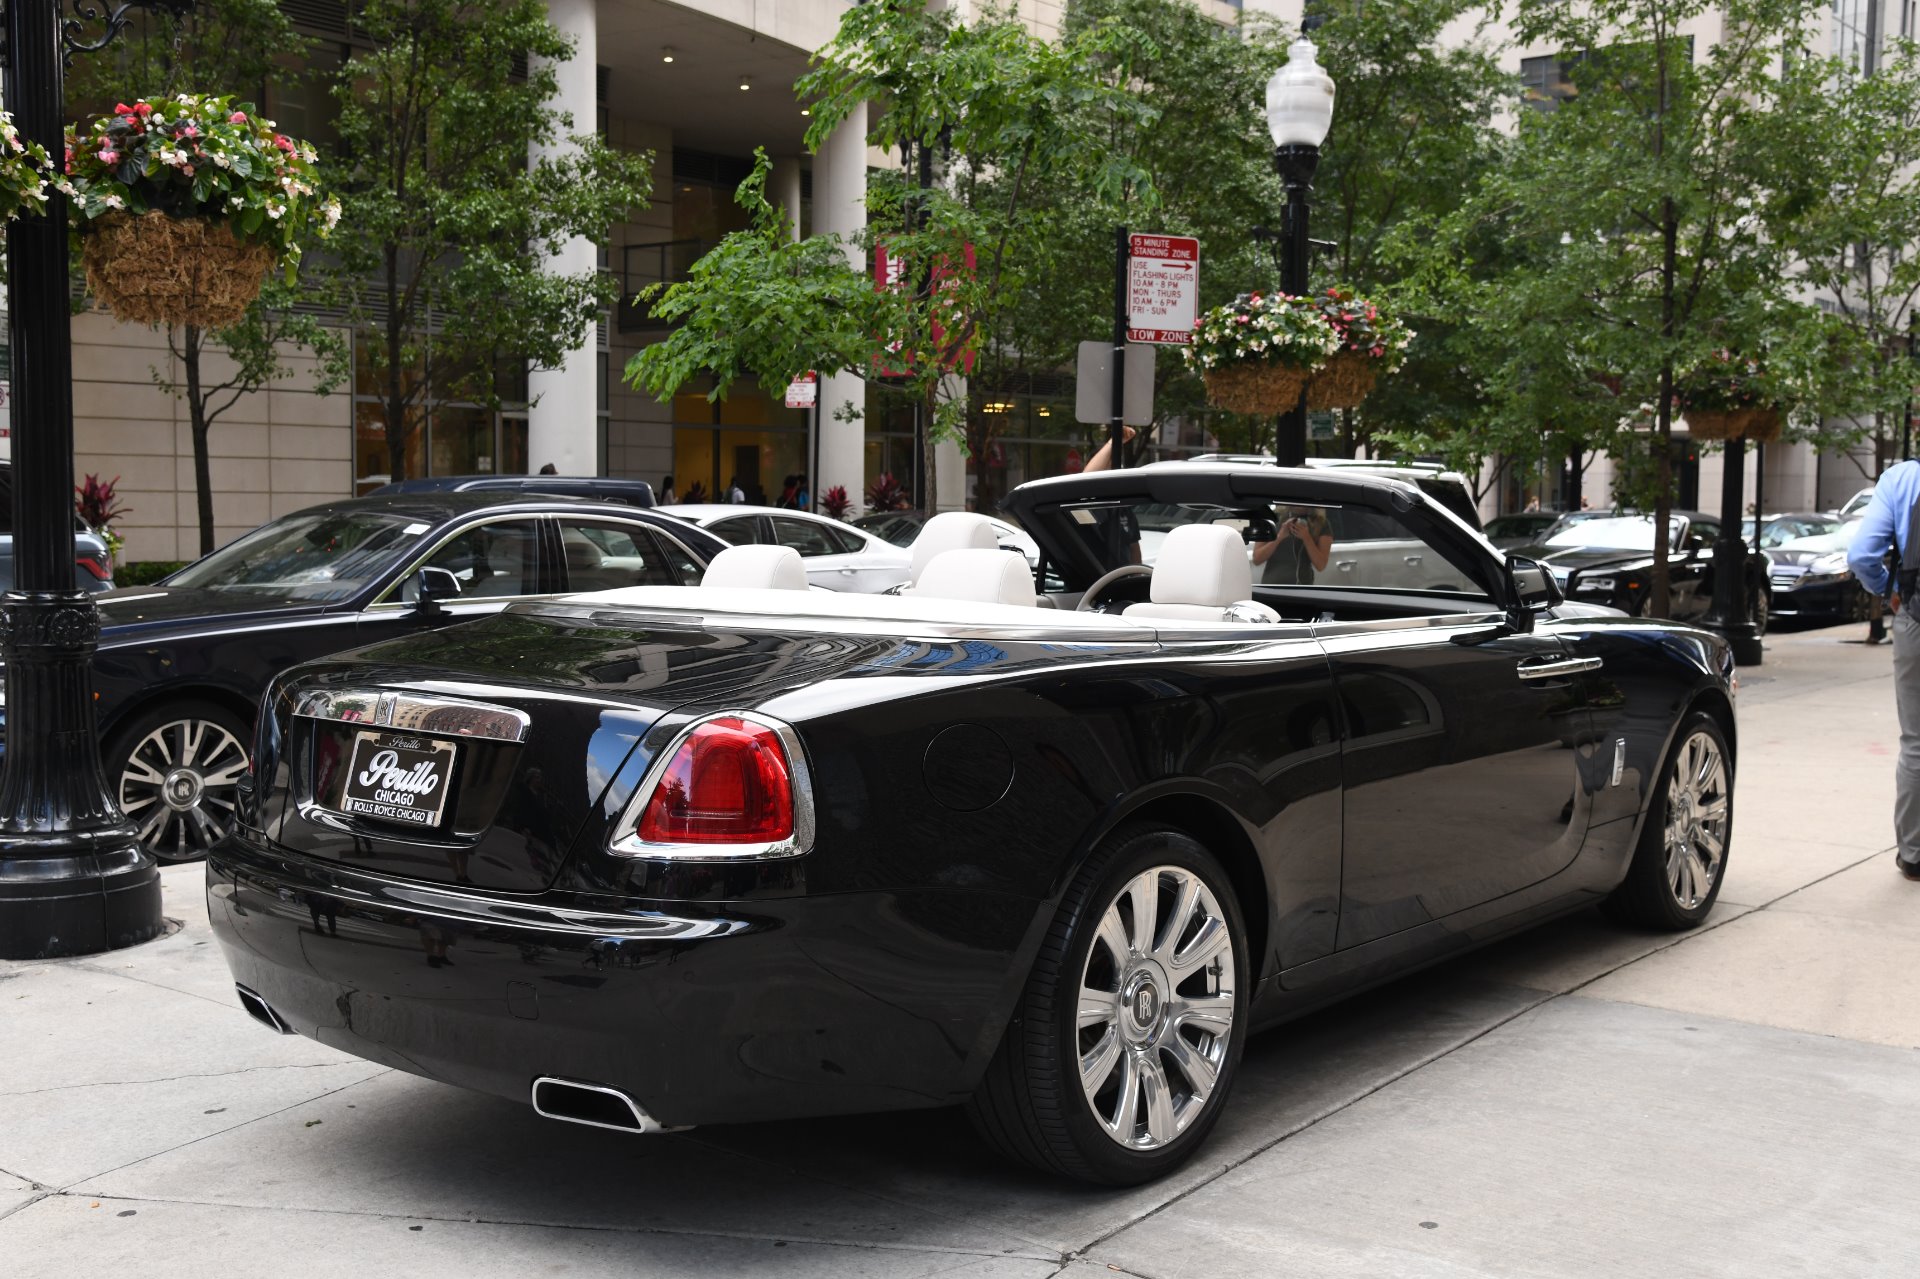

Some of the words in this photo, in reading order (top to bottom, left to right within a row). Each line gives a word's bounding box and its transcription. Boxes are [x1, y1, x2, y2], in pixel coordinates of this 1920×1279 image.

[1134, 238, 1142, 246] 15
[1144, 238, 1170, 248] MINUTE
[1134, 248, 1169, 257] STANDING
[1172, 249, 1191, 259] ZONE
[1133, 261, 1148, 270] USE
[1133, 271, 1168, 280] FLASHING
[1169, 272, 1194, 282] LIGHTS
[1167, 281, 1178, 289] PM
[1133, 288, 1149, 297] MON
[1157, 289, 1182, 298] THURS
[1166, 299, 1177, 307] PM
[1132, 306, 1145, 314] FRI
[1151, 307, 1167, 315] SUN
[1132, 329, 1156, 341] TOW
[1160, 331, 1190, 342] ZONE
[389, 737, 421, 749] Perillo
[359, 750, 439, 795] Perillo
[375, 789, 414, 806] CHICAGO
[353, 801, 373, 812] ROLLS
[374, 805, 396, 816] ROYCE
[396, 809, 426, 821] CHICAGO
